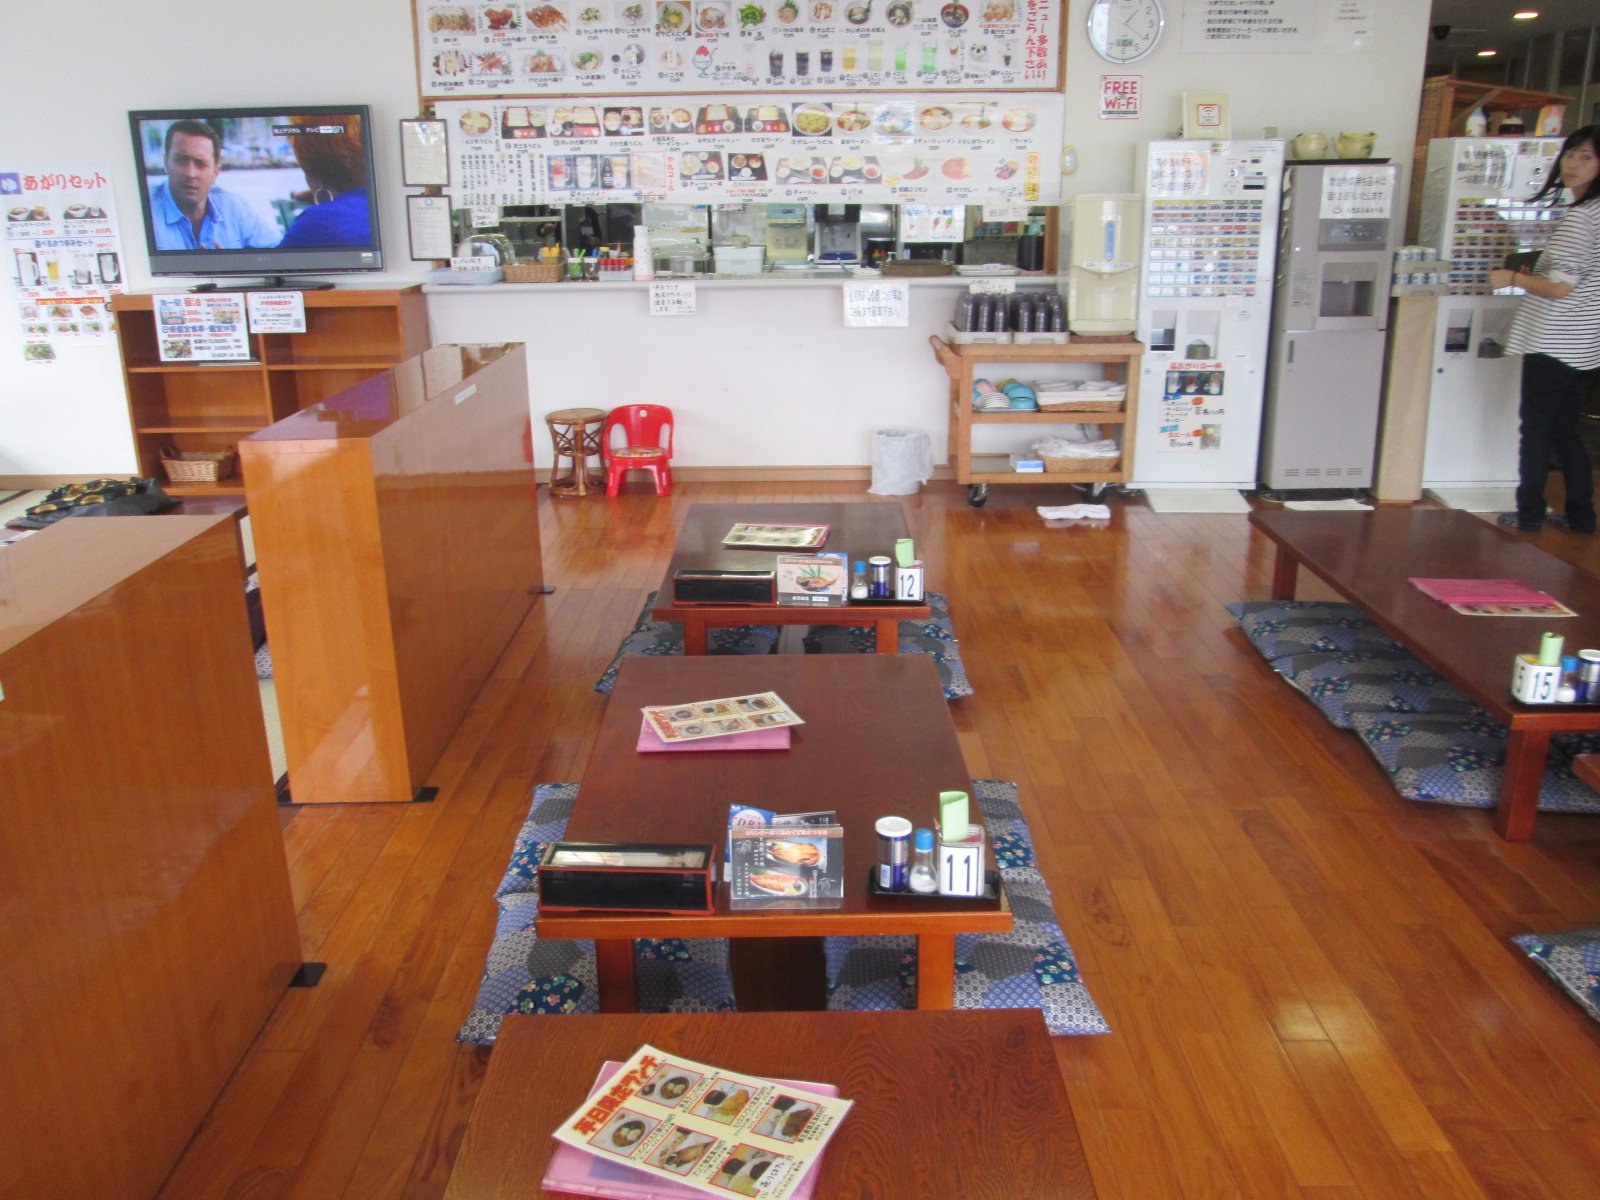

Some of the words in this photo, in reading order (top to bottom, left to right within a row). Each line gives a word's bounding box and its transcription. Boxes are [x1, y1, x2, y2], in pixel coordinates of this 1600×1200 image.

[1104, 81, 1137, 94] FREE
[1104, 97, 1137, 110] Wi-Fi
[24, 172, 106, 190] あがりセット
[900, 574, 915, 599] 12
[1532, 672, 1553, 700] 15
[945, 853, 972, 893] 11
[572, 1055, 658, 1136] 平日限定ランチ
